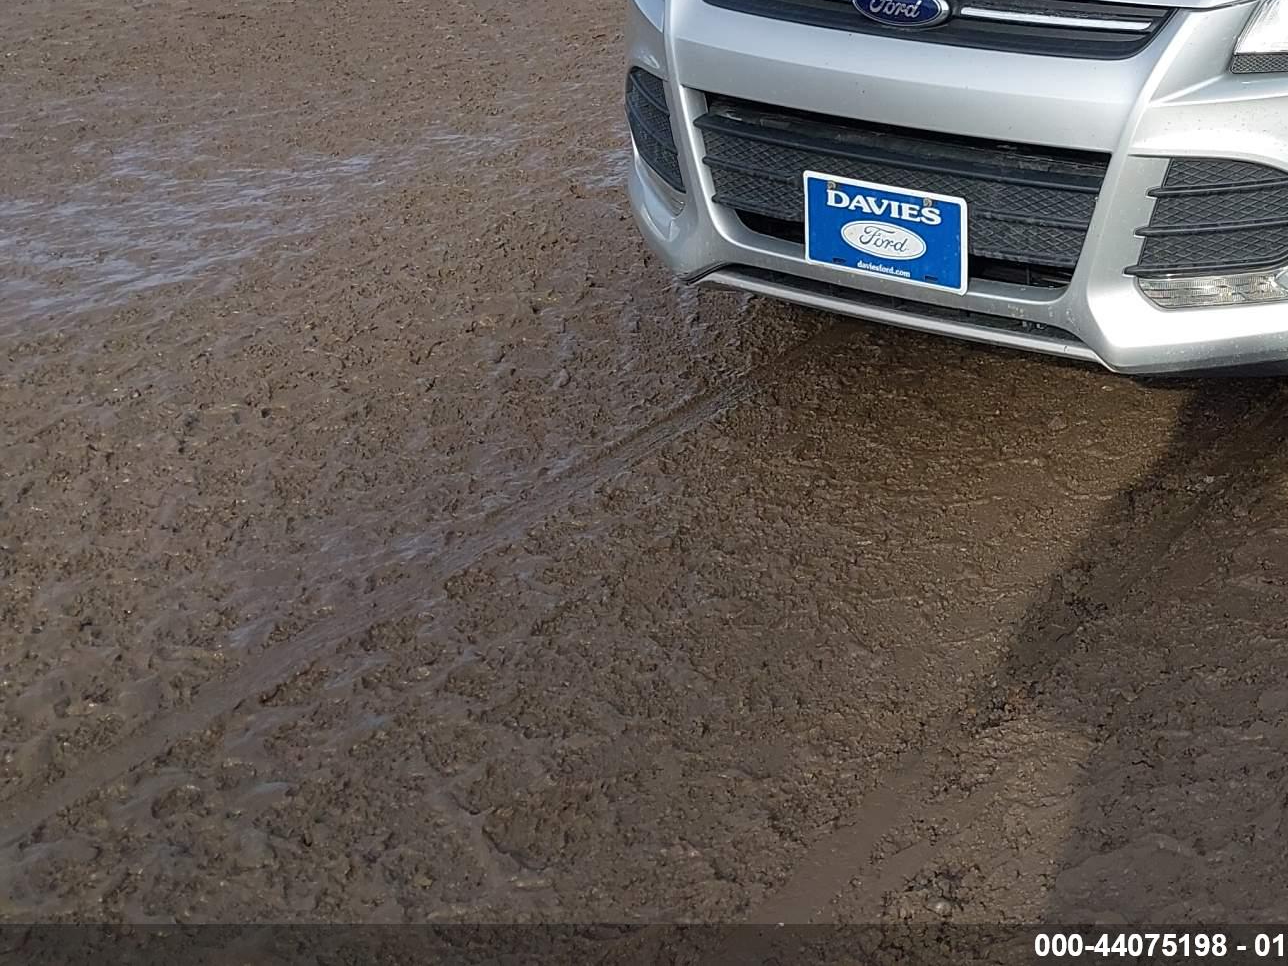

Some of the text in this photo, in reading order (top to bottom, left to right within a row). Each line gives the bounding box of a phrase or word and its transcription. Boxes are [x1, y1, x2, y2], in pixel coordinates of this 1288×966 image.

[826, 189, 942, 226] DAVIES
[858, 225, 909, 253] Ford
[856, 260, 911, 278] daviesford.com
